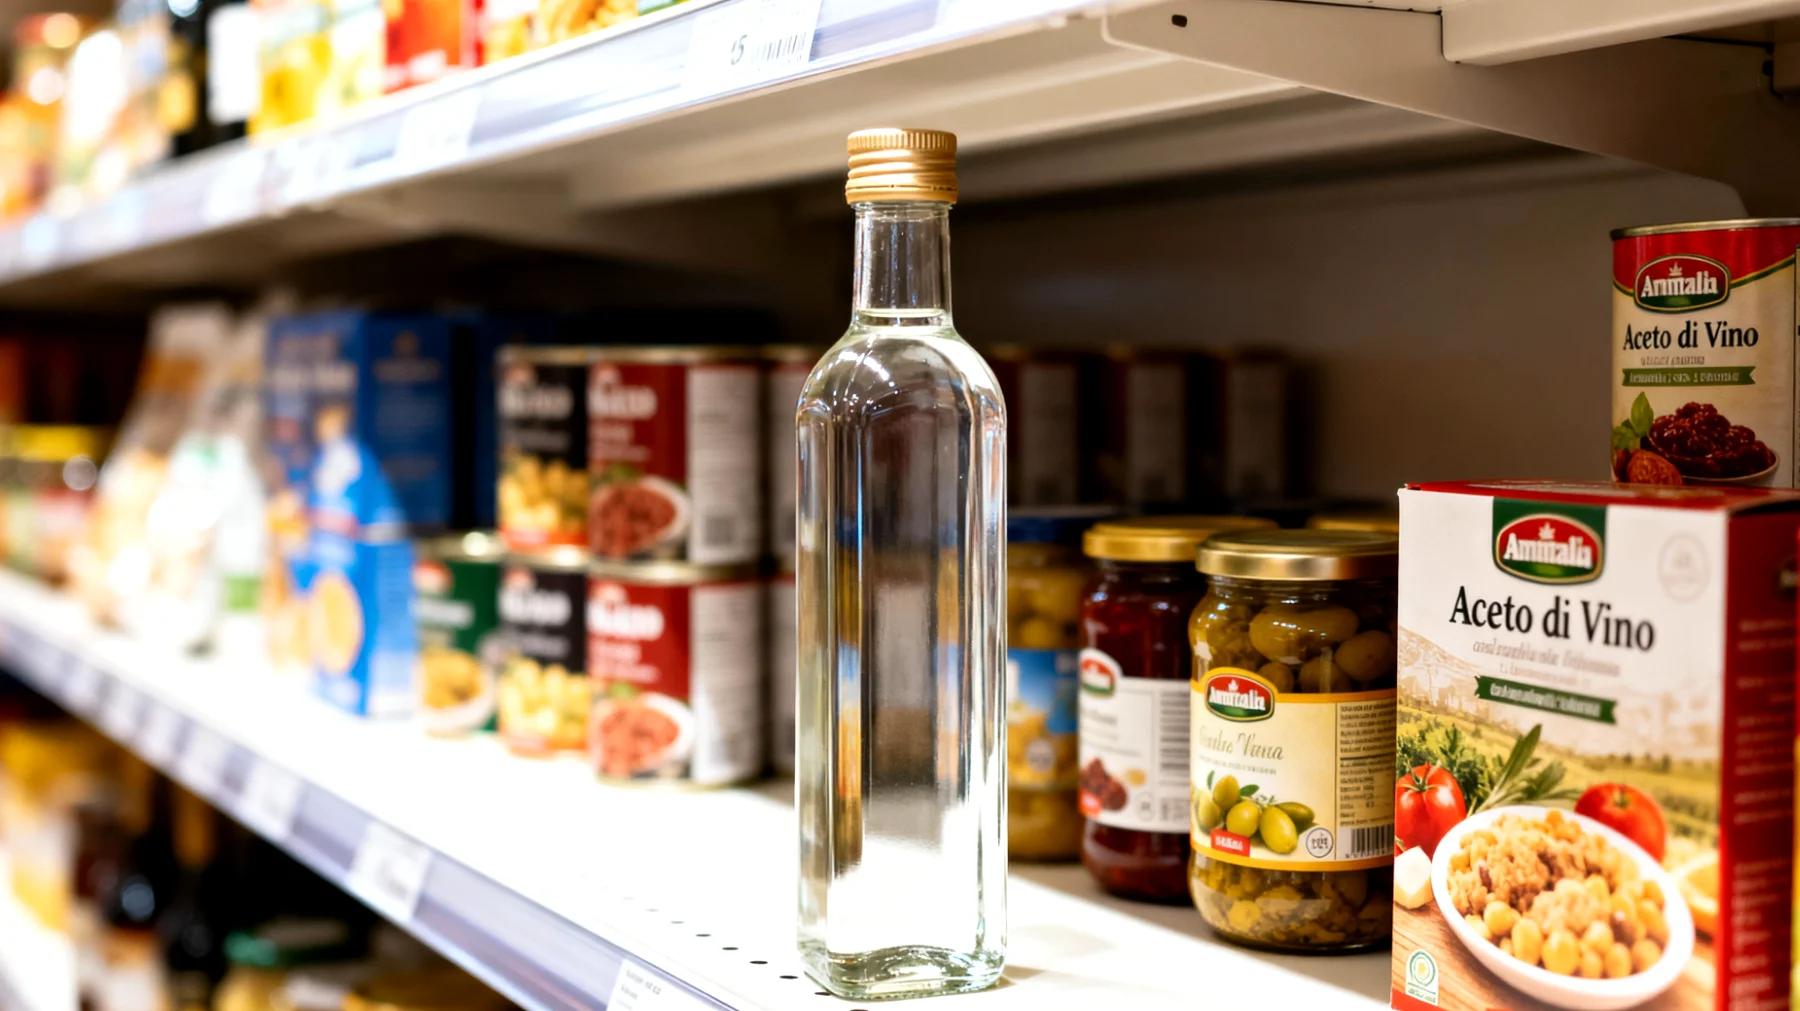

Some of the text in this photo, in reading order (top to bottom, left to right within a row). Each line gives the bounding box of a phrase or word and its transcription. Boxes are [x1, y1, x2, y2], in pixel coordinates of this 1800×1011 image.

[1623, 320, 1759, 350] Aceto di Vino
[1449, 586, 1656, 653] Aceto di Vino
